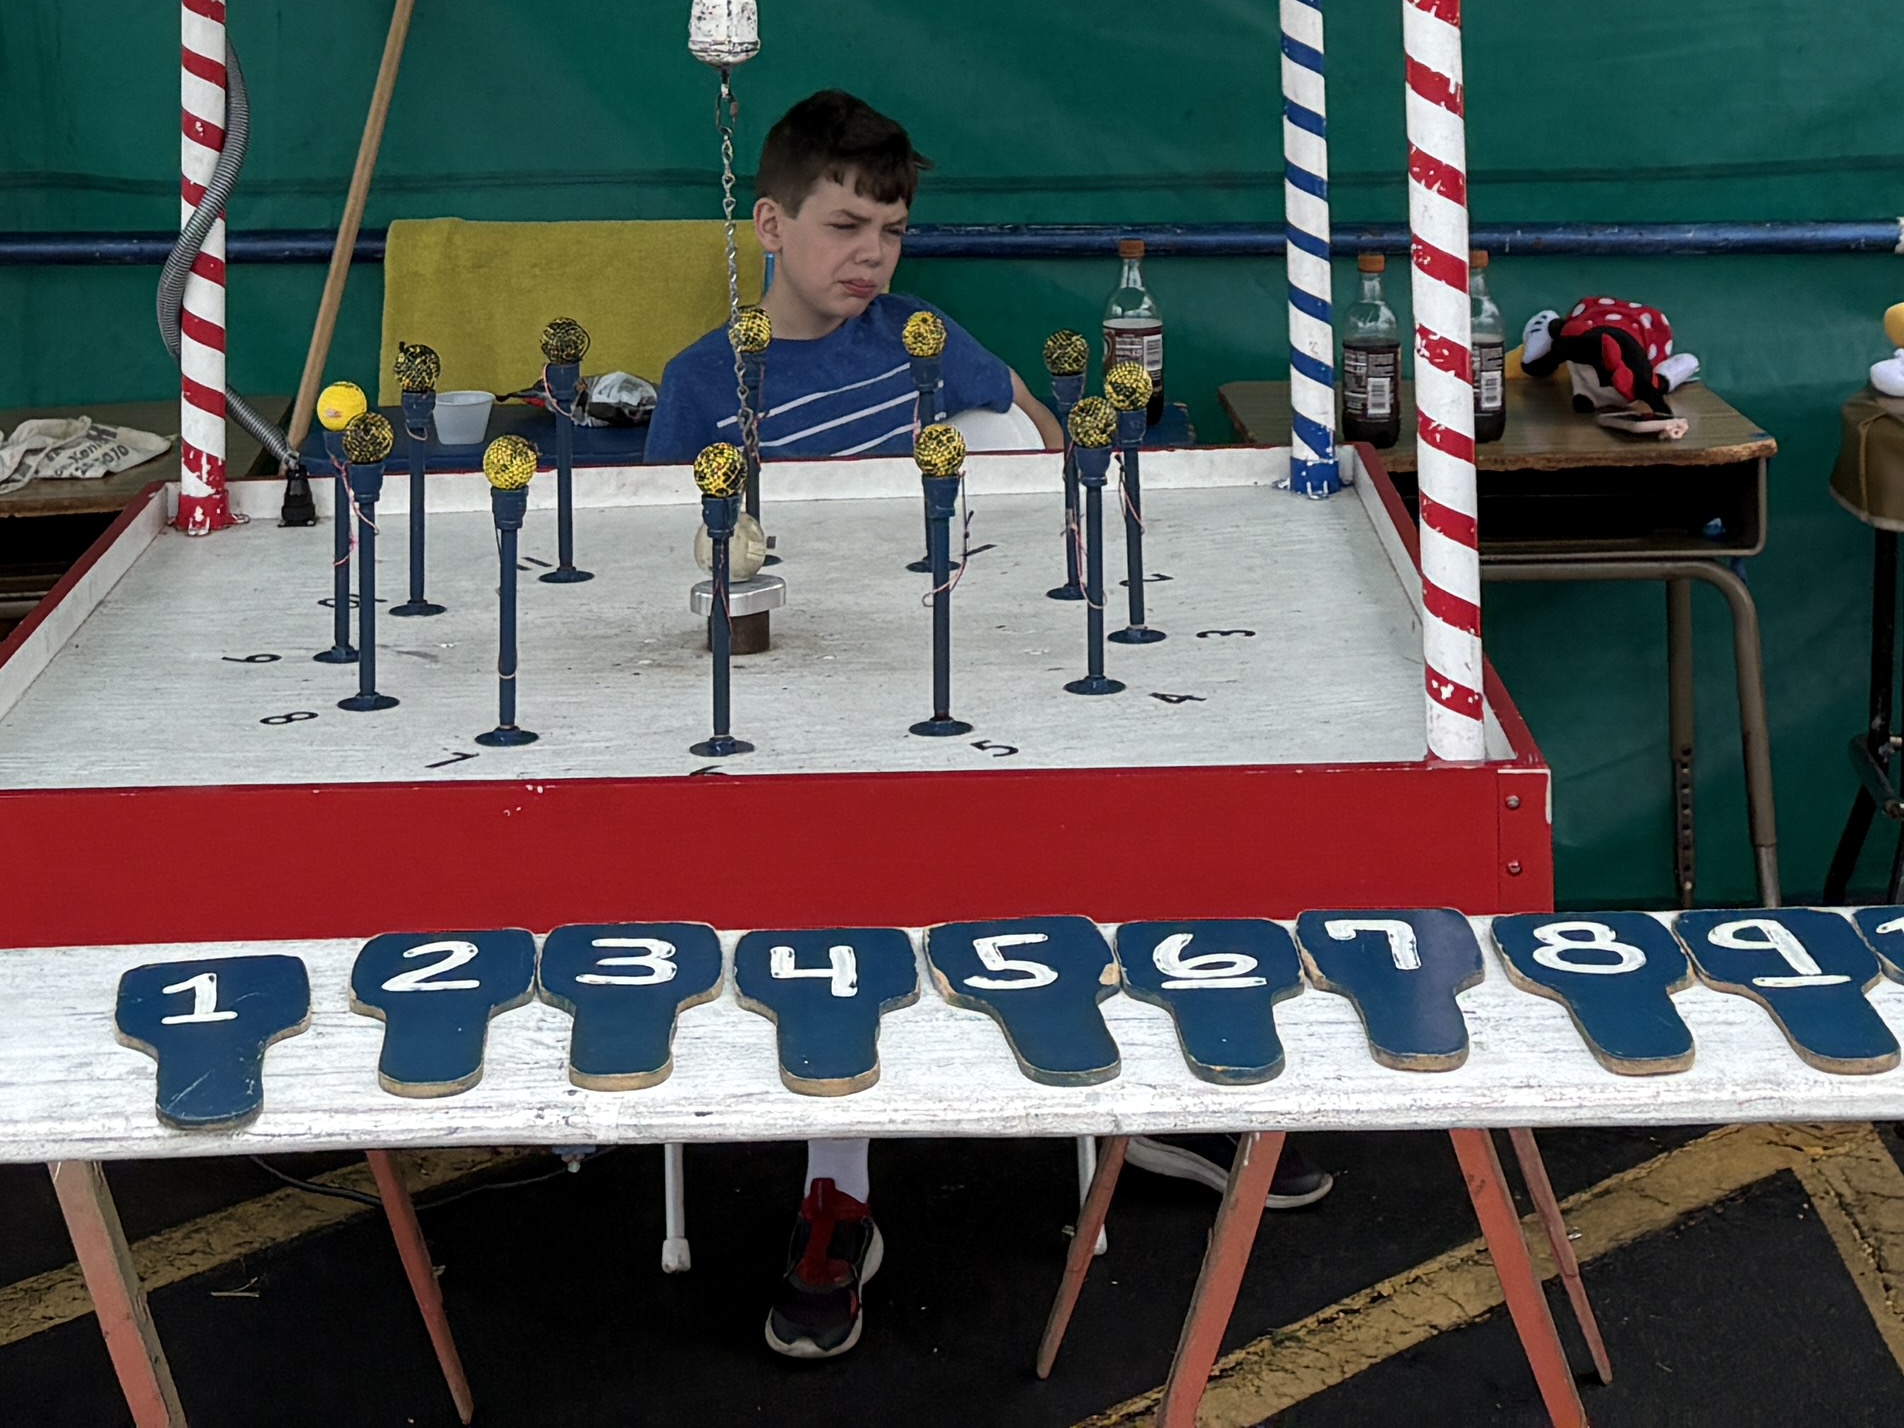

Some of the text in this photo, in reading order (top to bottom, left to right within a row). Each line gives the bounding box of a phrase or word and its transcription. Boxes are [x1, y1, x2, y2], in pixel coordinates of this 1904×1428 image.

[260, 711, 319, 725] 8
[969, 740, 1019, 757] 5
[380, 938, 482, 993] 2
[574, 936, 679, 986] 3
[769, 944, 860, 1000] 4
[962, 931, 1061, 990] 5
[1152, 932, 1266, 991] 6
[1324, 919, 1421, 971] 7
[1532, 920, 1649, 976] 8
[1706, 917, 1853, 988] 9
[160, 969, 239, 1027] 1
